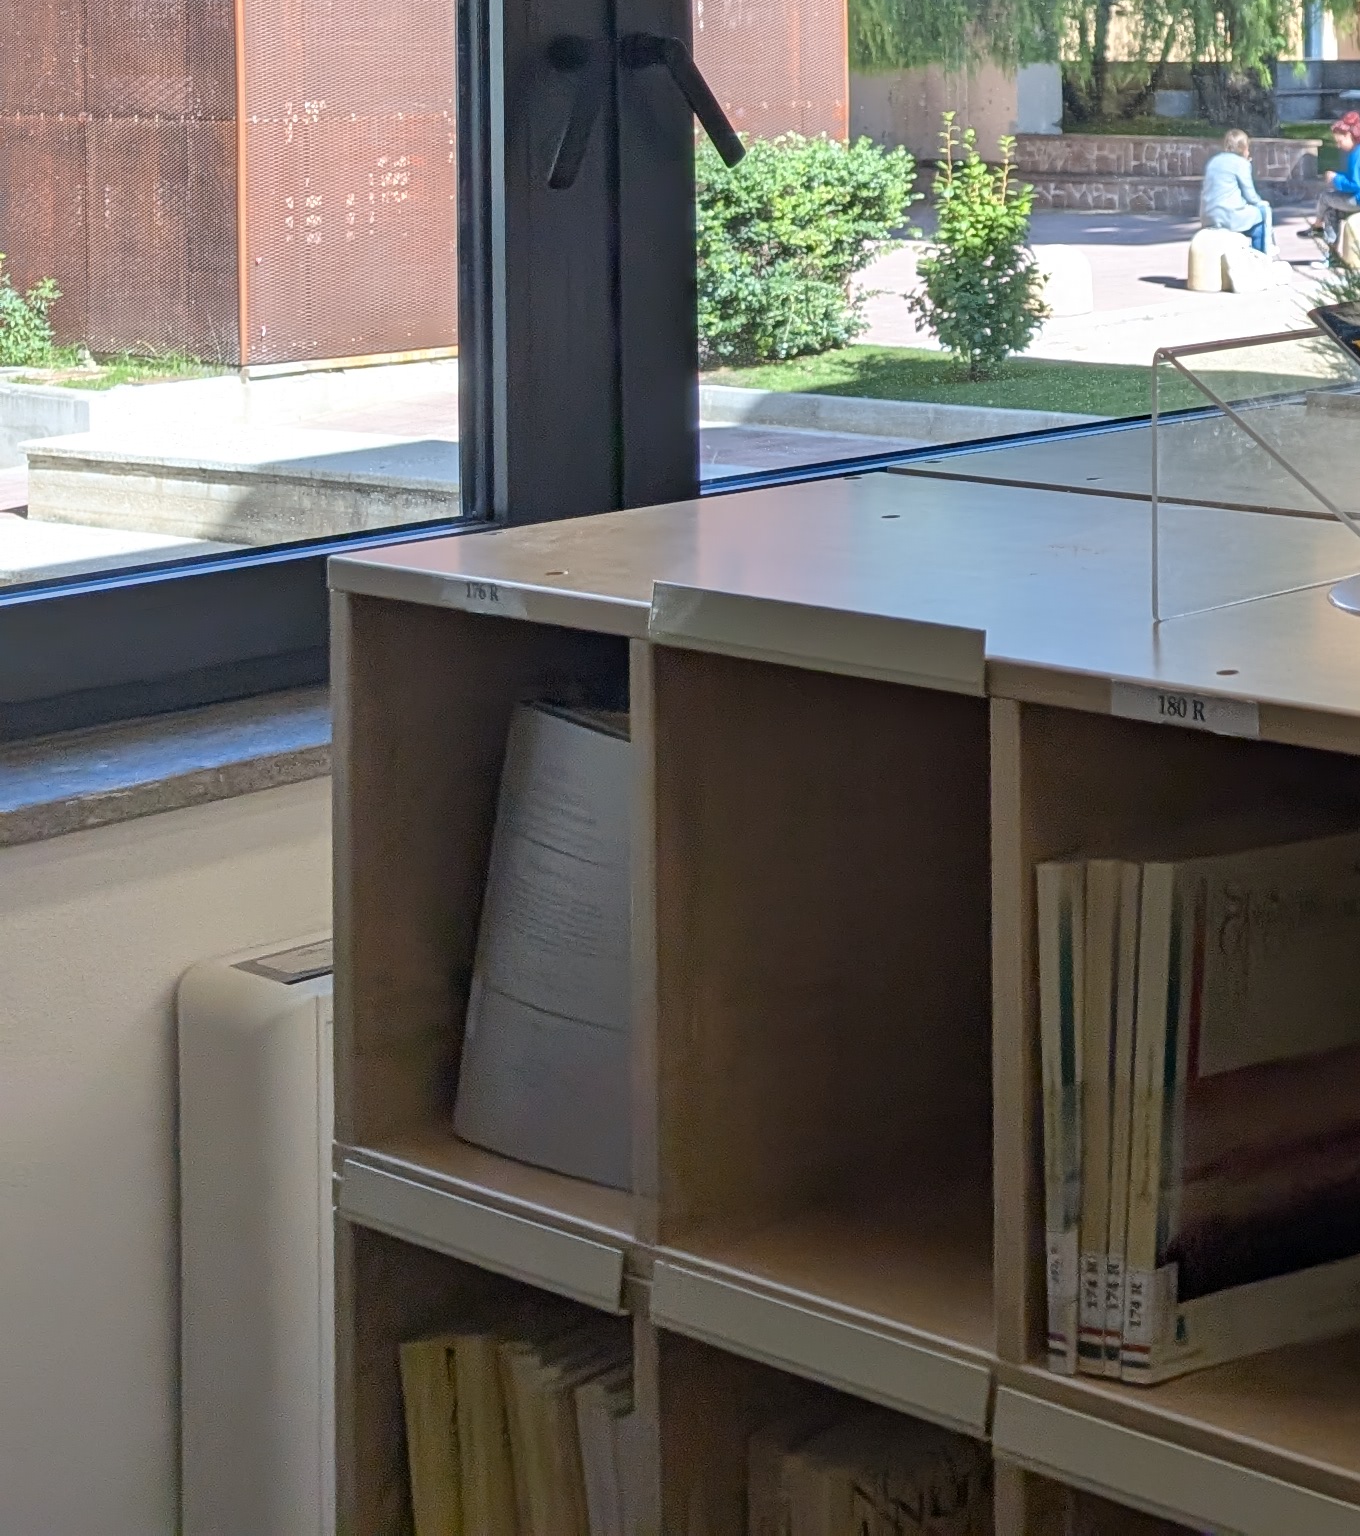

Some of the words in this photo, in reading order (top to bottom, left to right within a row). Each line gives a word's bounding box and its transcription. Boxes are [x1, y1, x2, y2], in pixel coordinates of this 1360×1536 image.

[490, 583, 499, 601] R
[1157, 695, 1187, 718] 180
[1192, 699, 1205, 722] R
